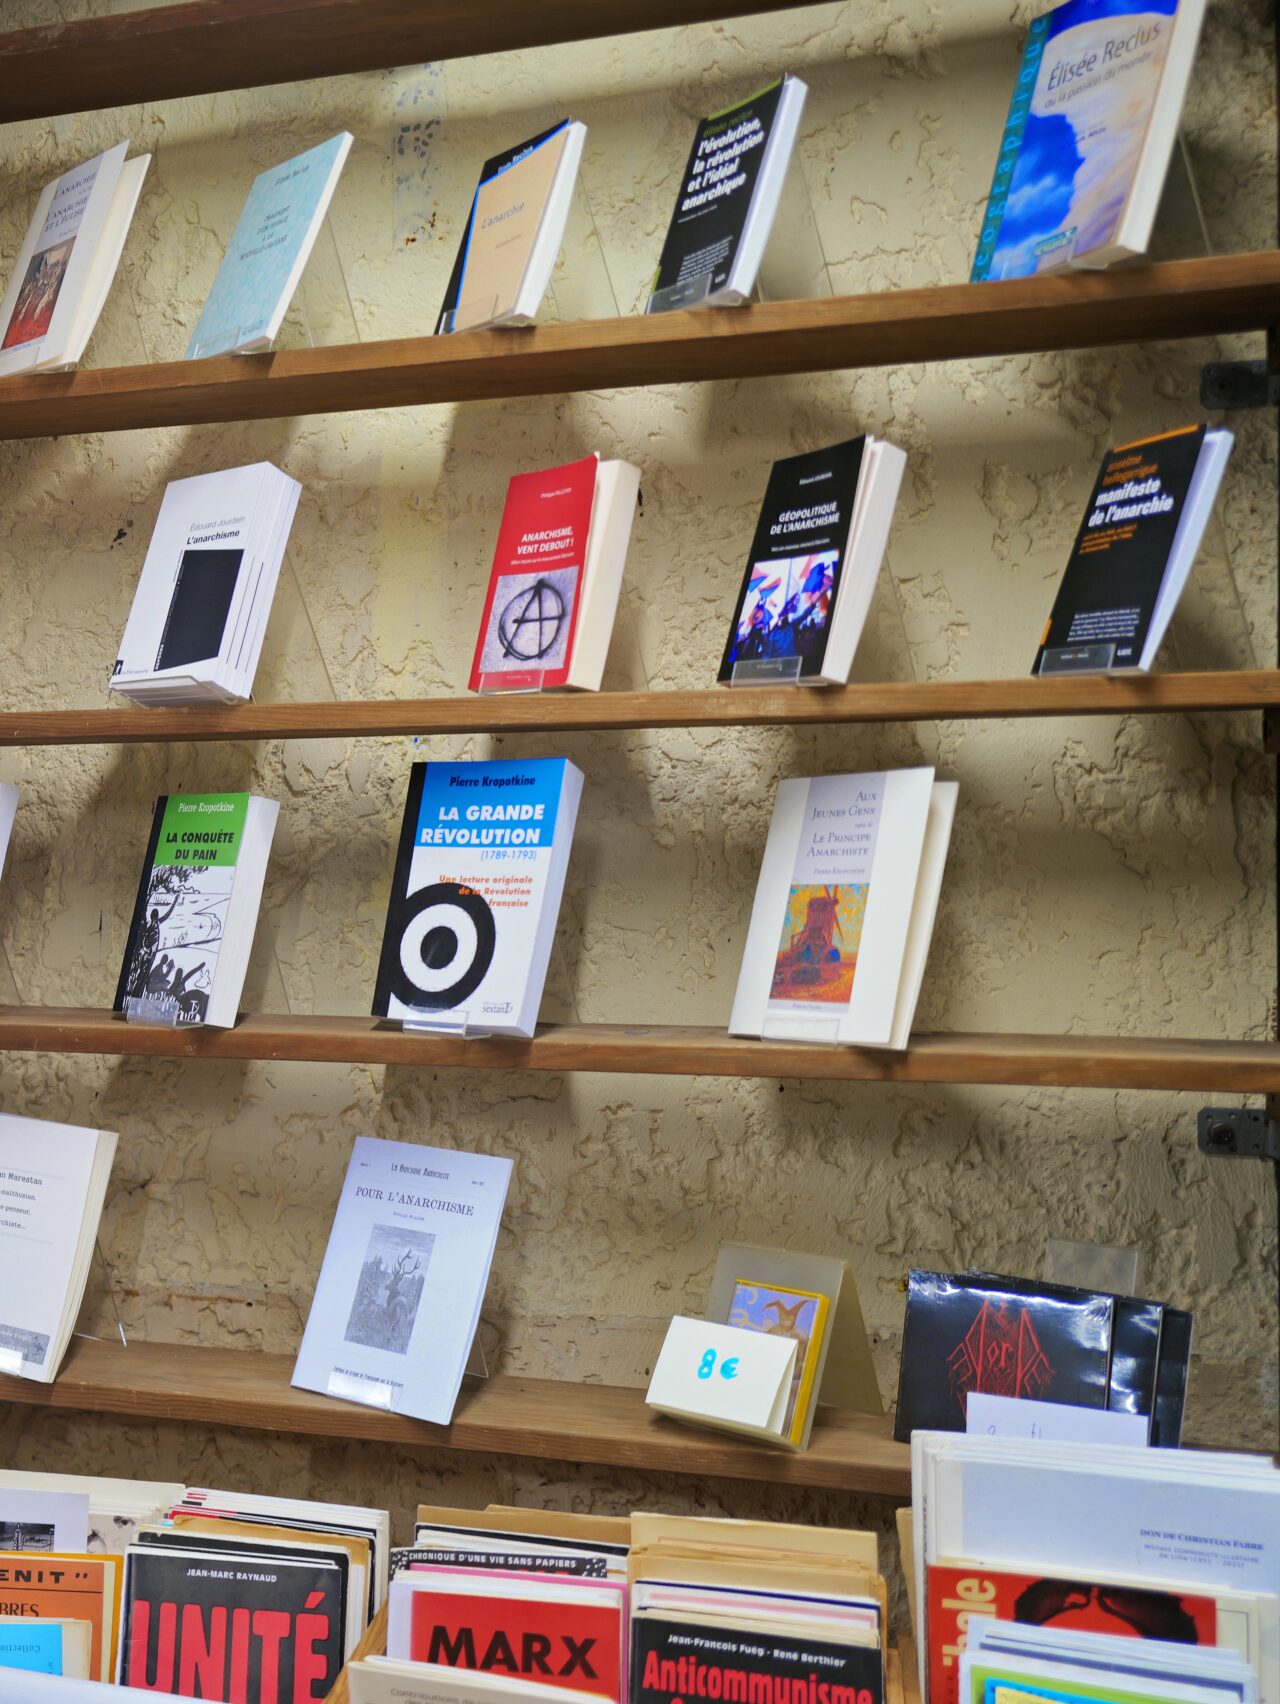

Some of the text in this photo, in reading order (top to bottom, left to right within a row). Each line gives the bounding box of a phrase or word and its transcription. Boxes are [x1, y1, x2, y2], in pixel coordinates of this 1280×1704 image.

[1047, 21, 1162, 93] Élisée Reclus
[692, 130, 765, 175] la révolution
[687, 156, 740, 193] et l'idéal
[681, 171, 747, 212] anarchique
[1095, 478, 1162, 508] manifeste
[778, 501, 839, 524] GÉOPOLITIQUE
[1088, 492, 1175, 528] de l'anarchie
[189, 514, 247, 533] Édouard Jourdain
[770, 512, 841, 536] DE L'ANARCHISME
[186, 530, 241, 546] L'anarchisme
[517, 540, 539, 556] VENT
[449, 773, 537, 789] Pierre Kropotkine
[178, 801, 236, 815] Pierre Kropotkine
[438, 803, 546, 822] LA GRANDE
[166, 828, 235, 844] LA CONQUÊTE
[420, 822, 542, 845] RÉVOLUTION
[174, 849, 218, 861] DU PAIN
[480, 849, 538, 862] (1789-1793)
[439, 874, 534, 887] Une lecture originale
[457, 885, 532, 897] de Révolution
[486, 897, 530, 909] française
[7, 1172, 44, 1187] Marestan
[355, 1186, 475, 1217] POUR L'ANARCHISME
[1140, 1528, 1265, 1552] DON DE CHRISTIAN FABRE
[408, 1551, 577, 1569] CHRONIQUE D'UNE VIE SANS PAPIERS
[186, 1568, 278, 1583] JEAN-MARC RAYNAUD
[128, 1591, 330, 1704] UNITÉ
[426, 1625, 598, 1680] MARX
[773, 1648, 847, 1668] René Berthier
[642, 1650, 875, 1704] Anticommunisme
